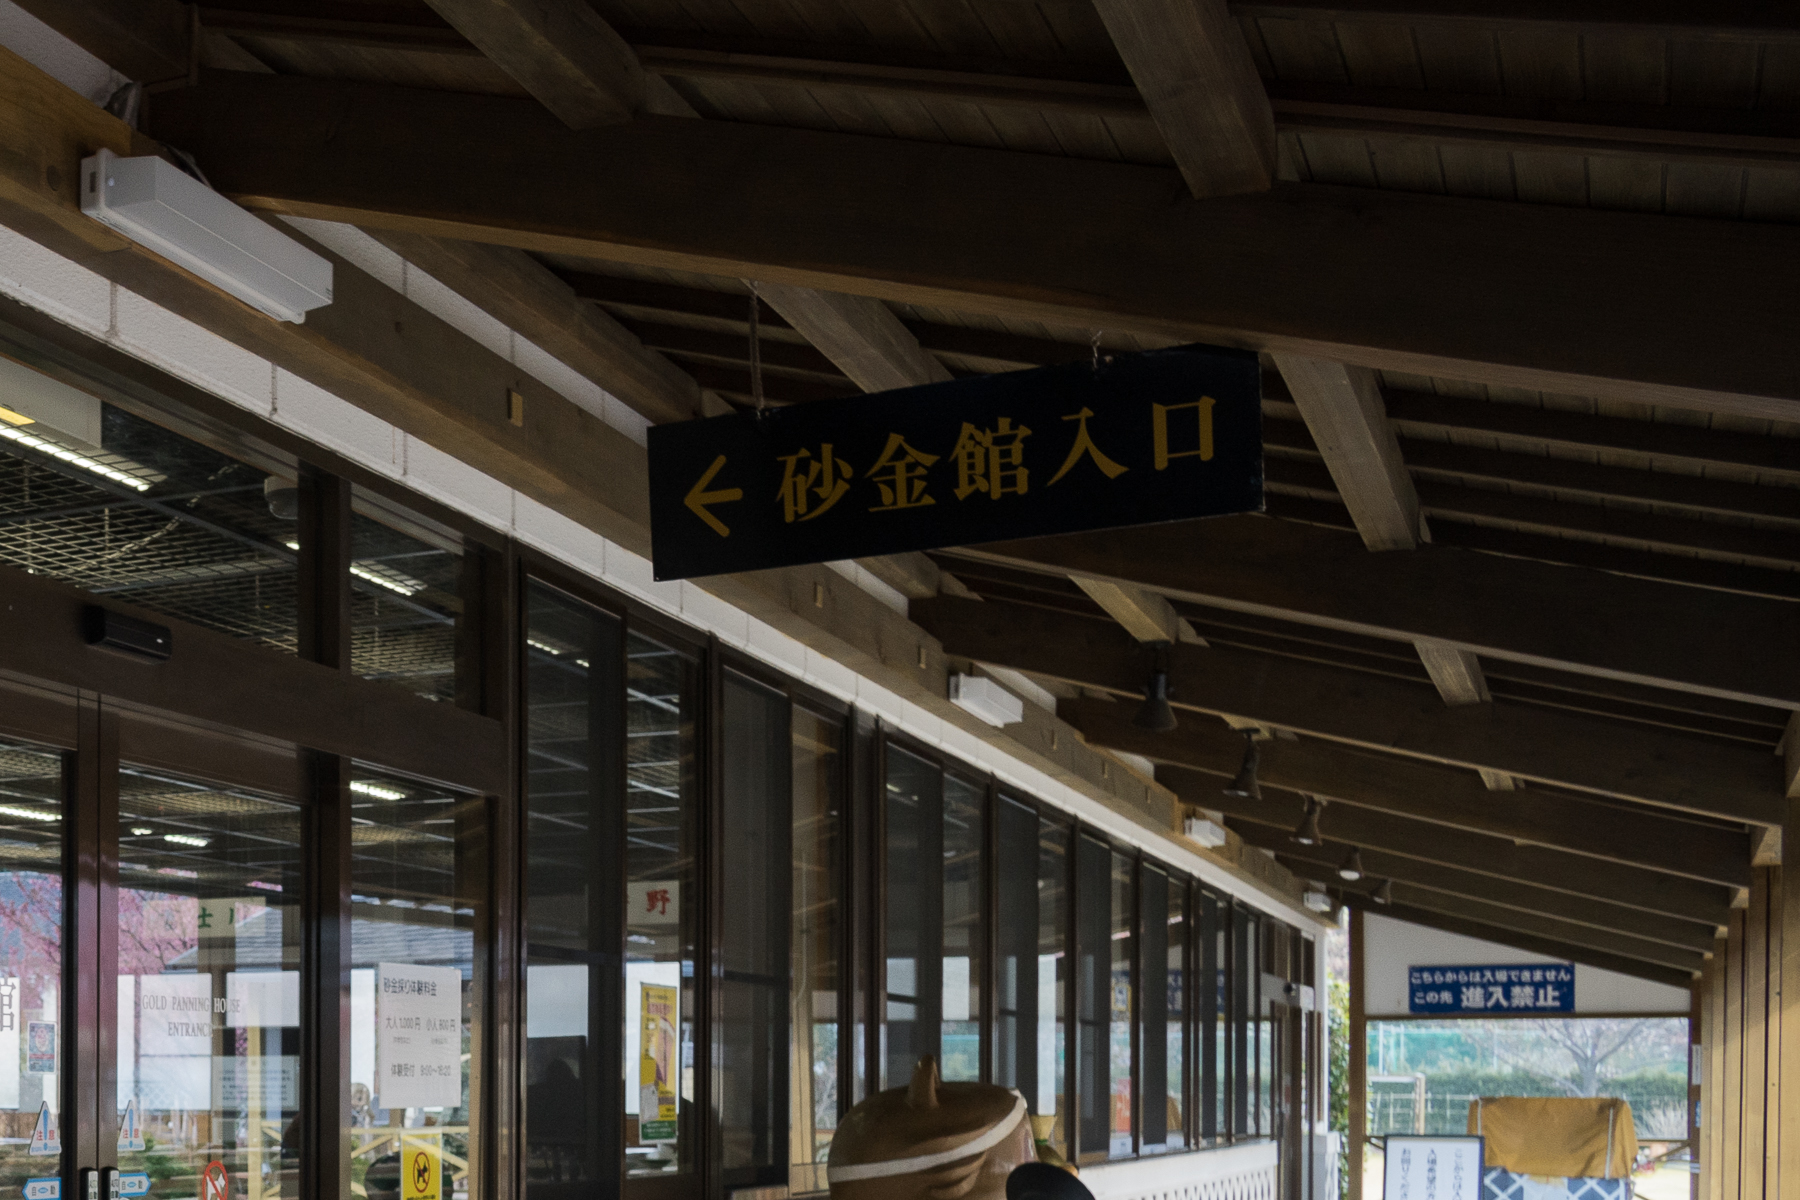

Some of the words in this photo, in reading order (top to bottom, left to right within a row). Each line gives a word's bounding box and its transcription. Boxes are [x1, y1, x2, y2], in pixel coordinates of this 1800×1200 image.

[775, 396, 1217, 524] 砂金館入口
[383, 976, 437, 997] 砂金採り体験料金
[1411, 969, 1571, 985] こちらからは入場できません
[142, 994, 168, 1011] GOLD
[171, 996, 210, 1013] PANNING
[213, 997, 241, 1014] HOUSE
[1414, 990, 1453, 1005] この先
[1460, 984, 1561, 1009] 進入禁止
[167, 1021, 214, 1038] ENTRANCE
